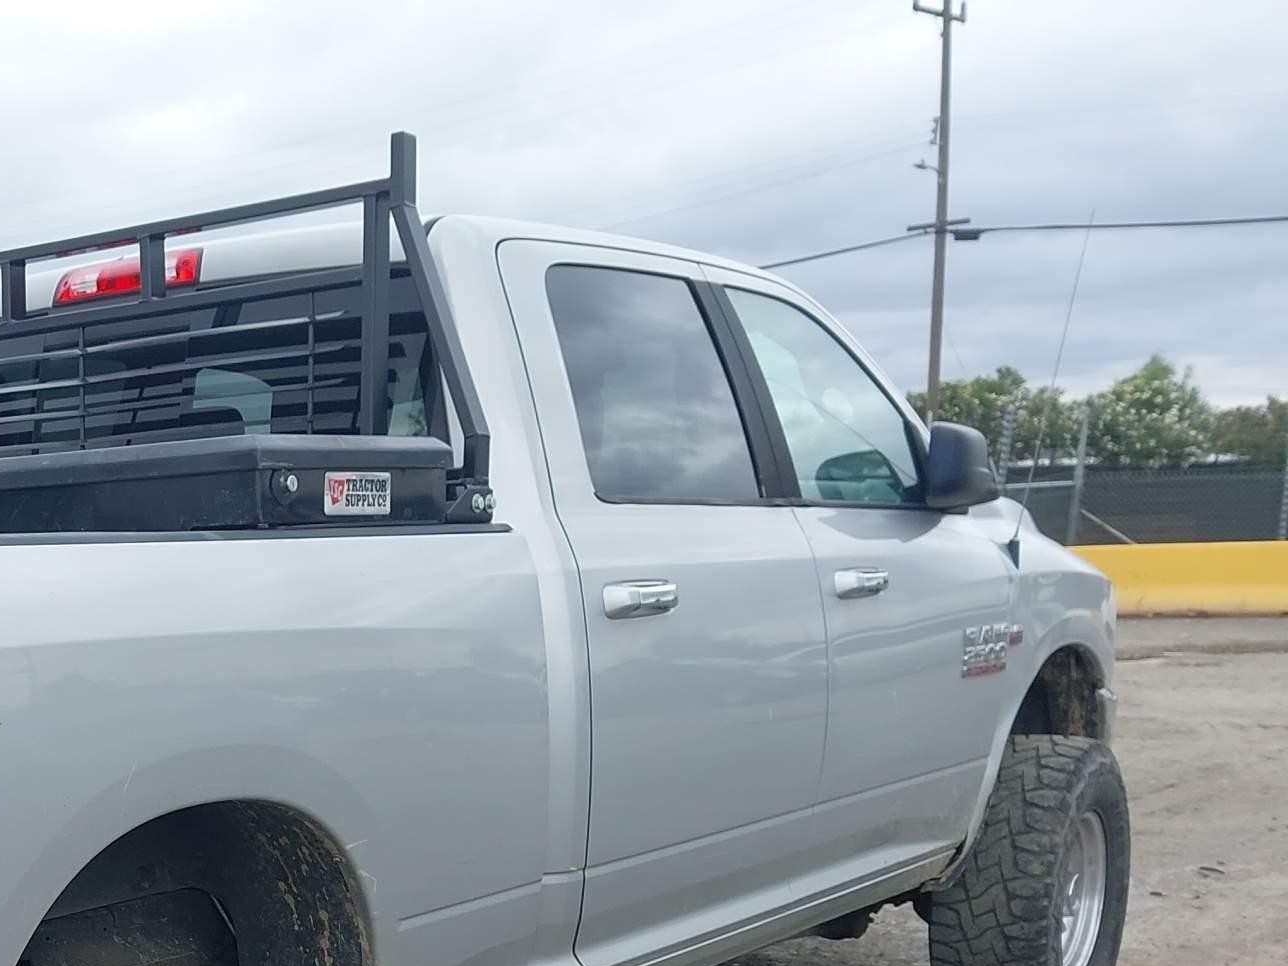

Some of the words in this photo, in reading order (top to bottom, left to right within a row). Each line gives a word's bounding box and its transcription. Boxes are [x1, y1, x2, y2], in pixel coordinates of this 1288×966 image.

[345, 478, 387, 492] TRACTOR
[345, 494, 376, 507] SUPPLY
[963, 642, 1007, 662] 2500
